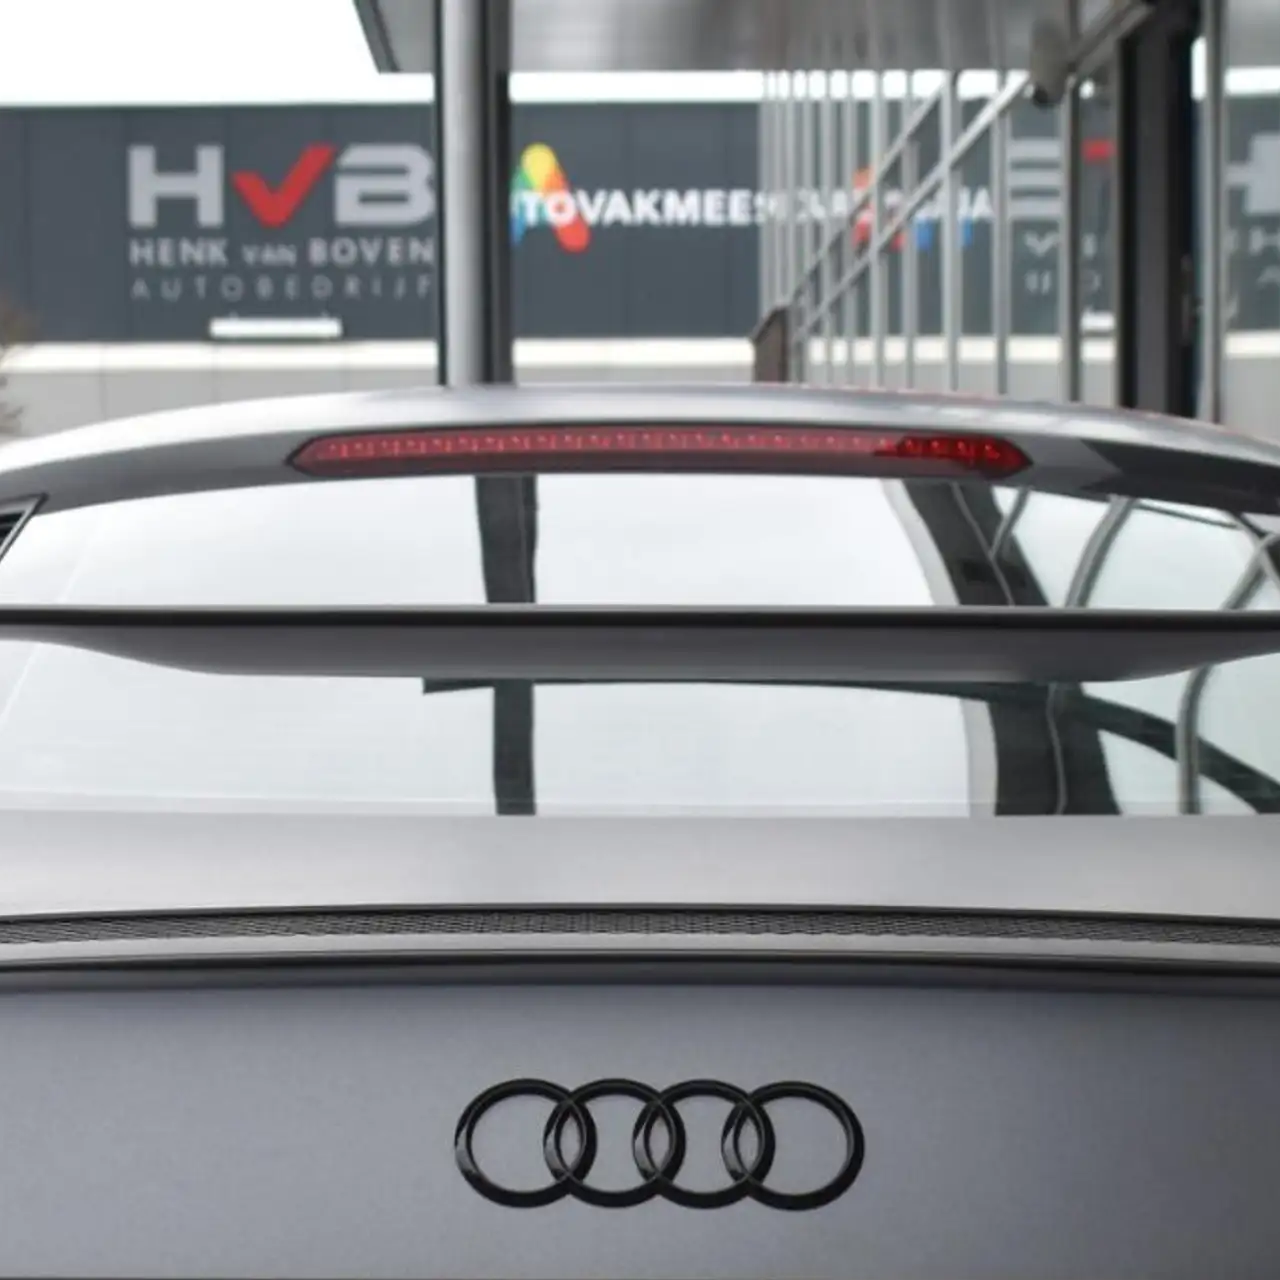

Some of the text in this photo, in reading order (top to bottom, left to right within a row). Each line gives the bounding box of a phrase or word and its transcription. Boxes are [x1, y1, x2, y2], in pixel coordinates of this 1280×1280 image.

[129, 238, 228, 267] HENK
[308, 237, 435, 266] BOVEN
[130, 274, 433, 301] AUTOBEDRIJF
